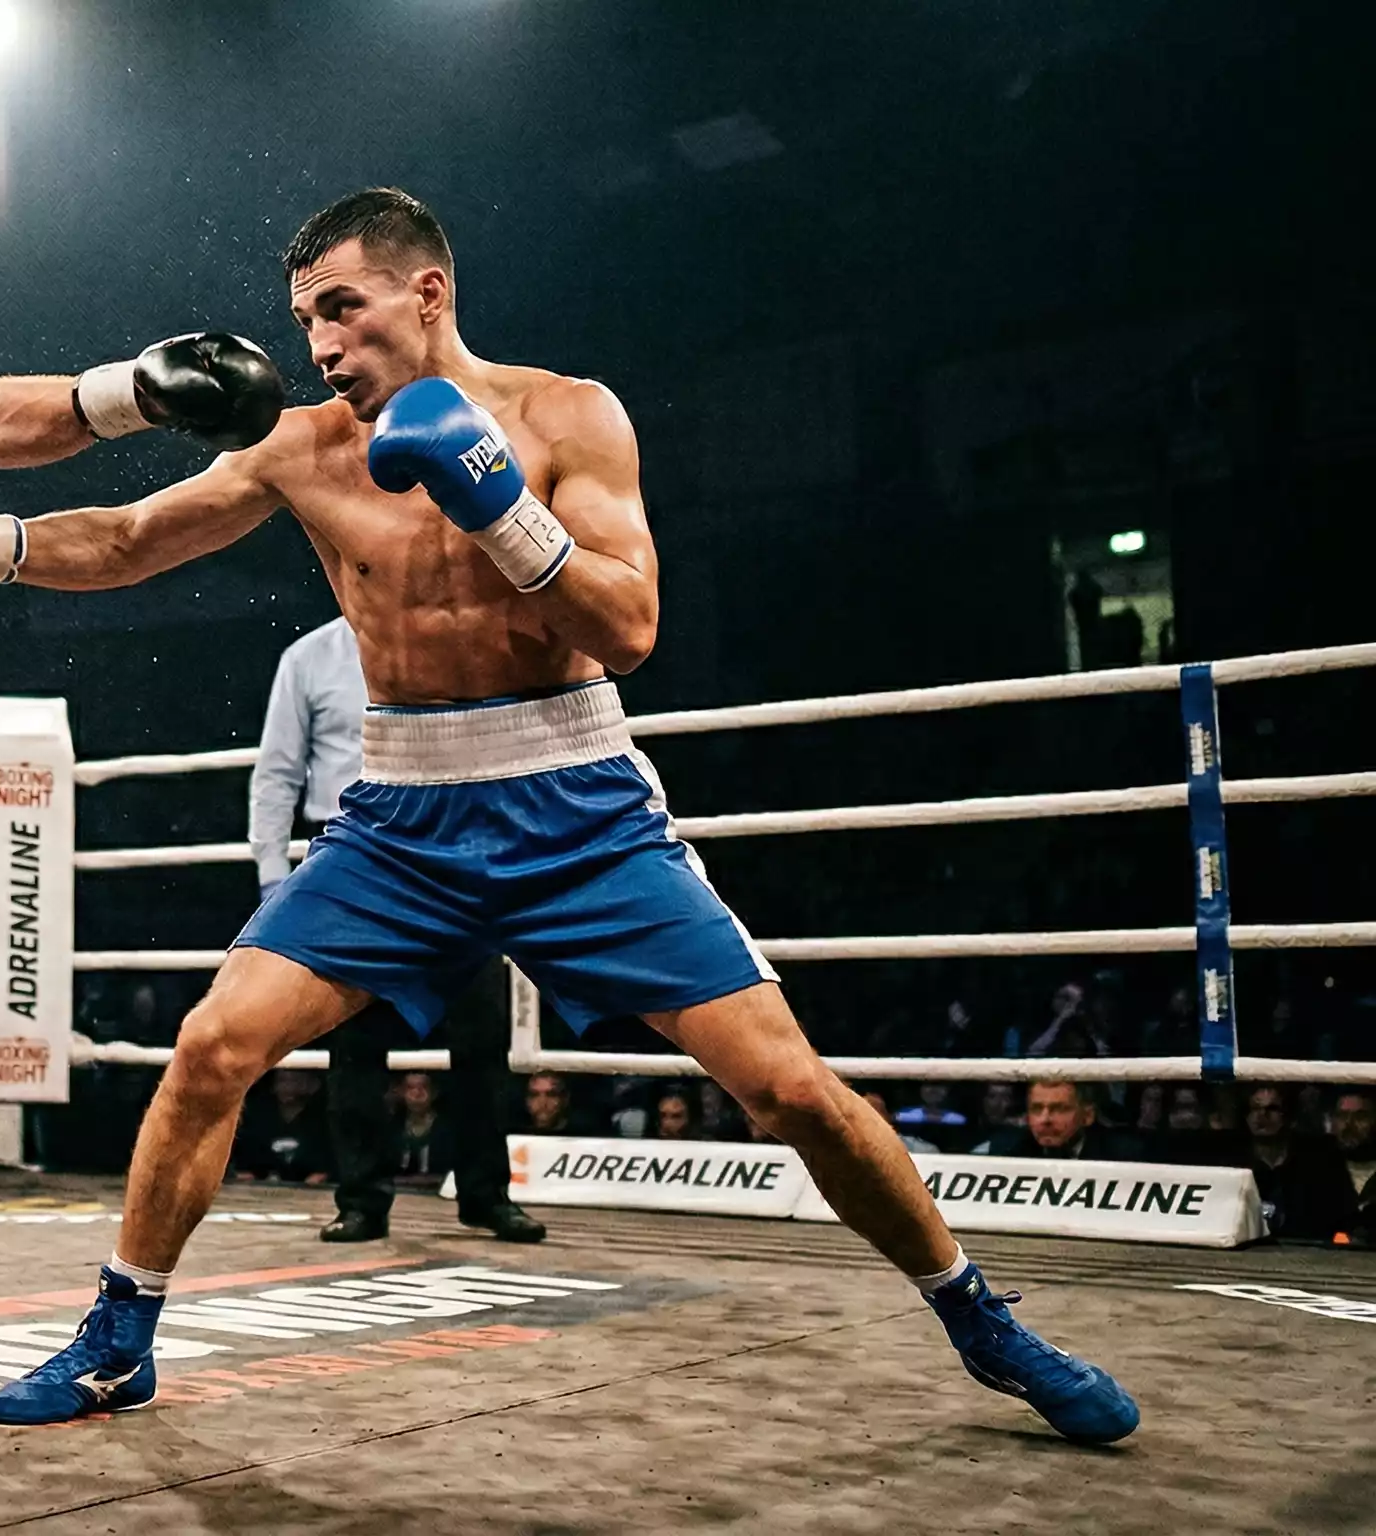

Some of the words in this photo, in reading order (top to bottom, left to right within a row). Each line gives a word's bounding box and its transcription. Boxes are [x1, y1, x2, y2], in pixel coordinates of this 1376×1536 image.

[8, 821, 40, 1020] ADRENALINE
[543, 1153, 786, 1190] ADRENALINE
[924, 1172, 1212, 1216] ADRENALINE
[158, 1266, 623, 1339] NIGHT
